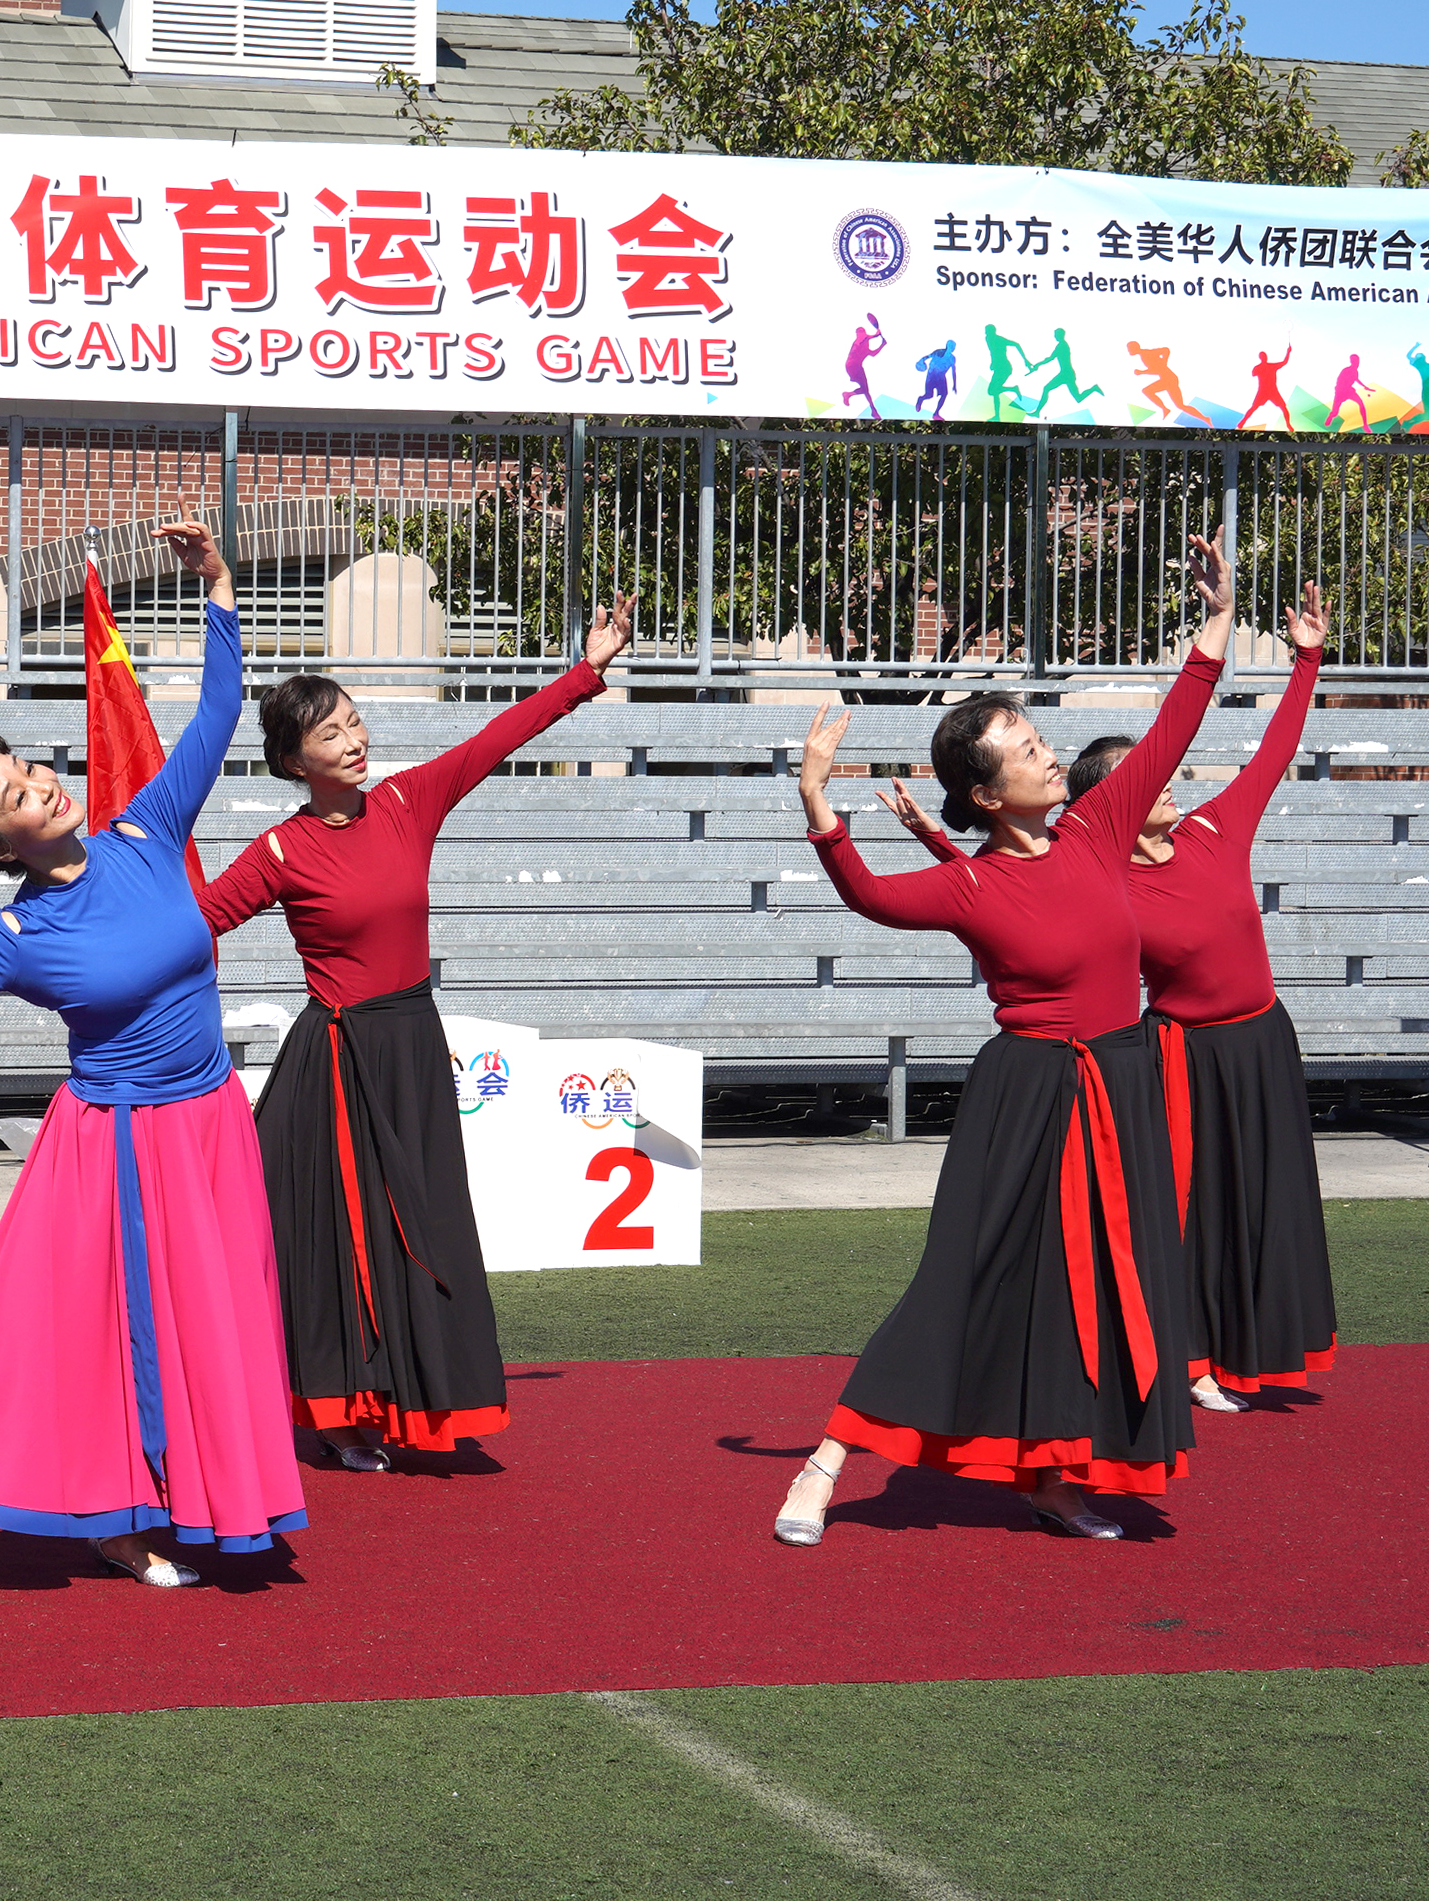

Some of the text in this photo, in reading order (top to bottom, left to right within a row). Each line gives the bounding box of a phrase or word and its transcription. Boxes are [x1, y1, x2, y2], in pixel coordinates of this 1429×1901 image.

[933, 212, 1429, 271] 主办方：全美华人侨团联合
[936, 265, 1419, 303] Sponsor: Federation of Chinese American
[209, 326, 505, 381] SPORTS
[536, 334, 737, 385] GAME
[560, 1092, 633, 1114] 侨运
[583, 1147, 654, 1250] 2
